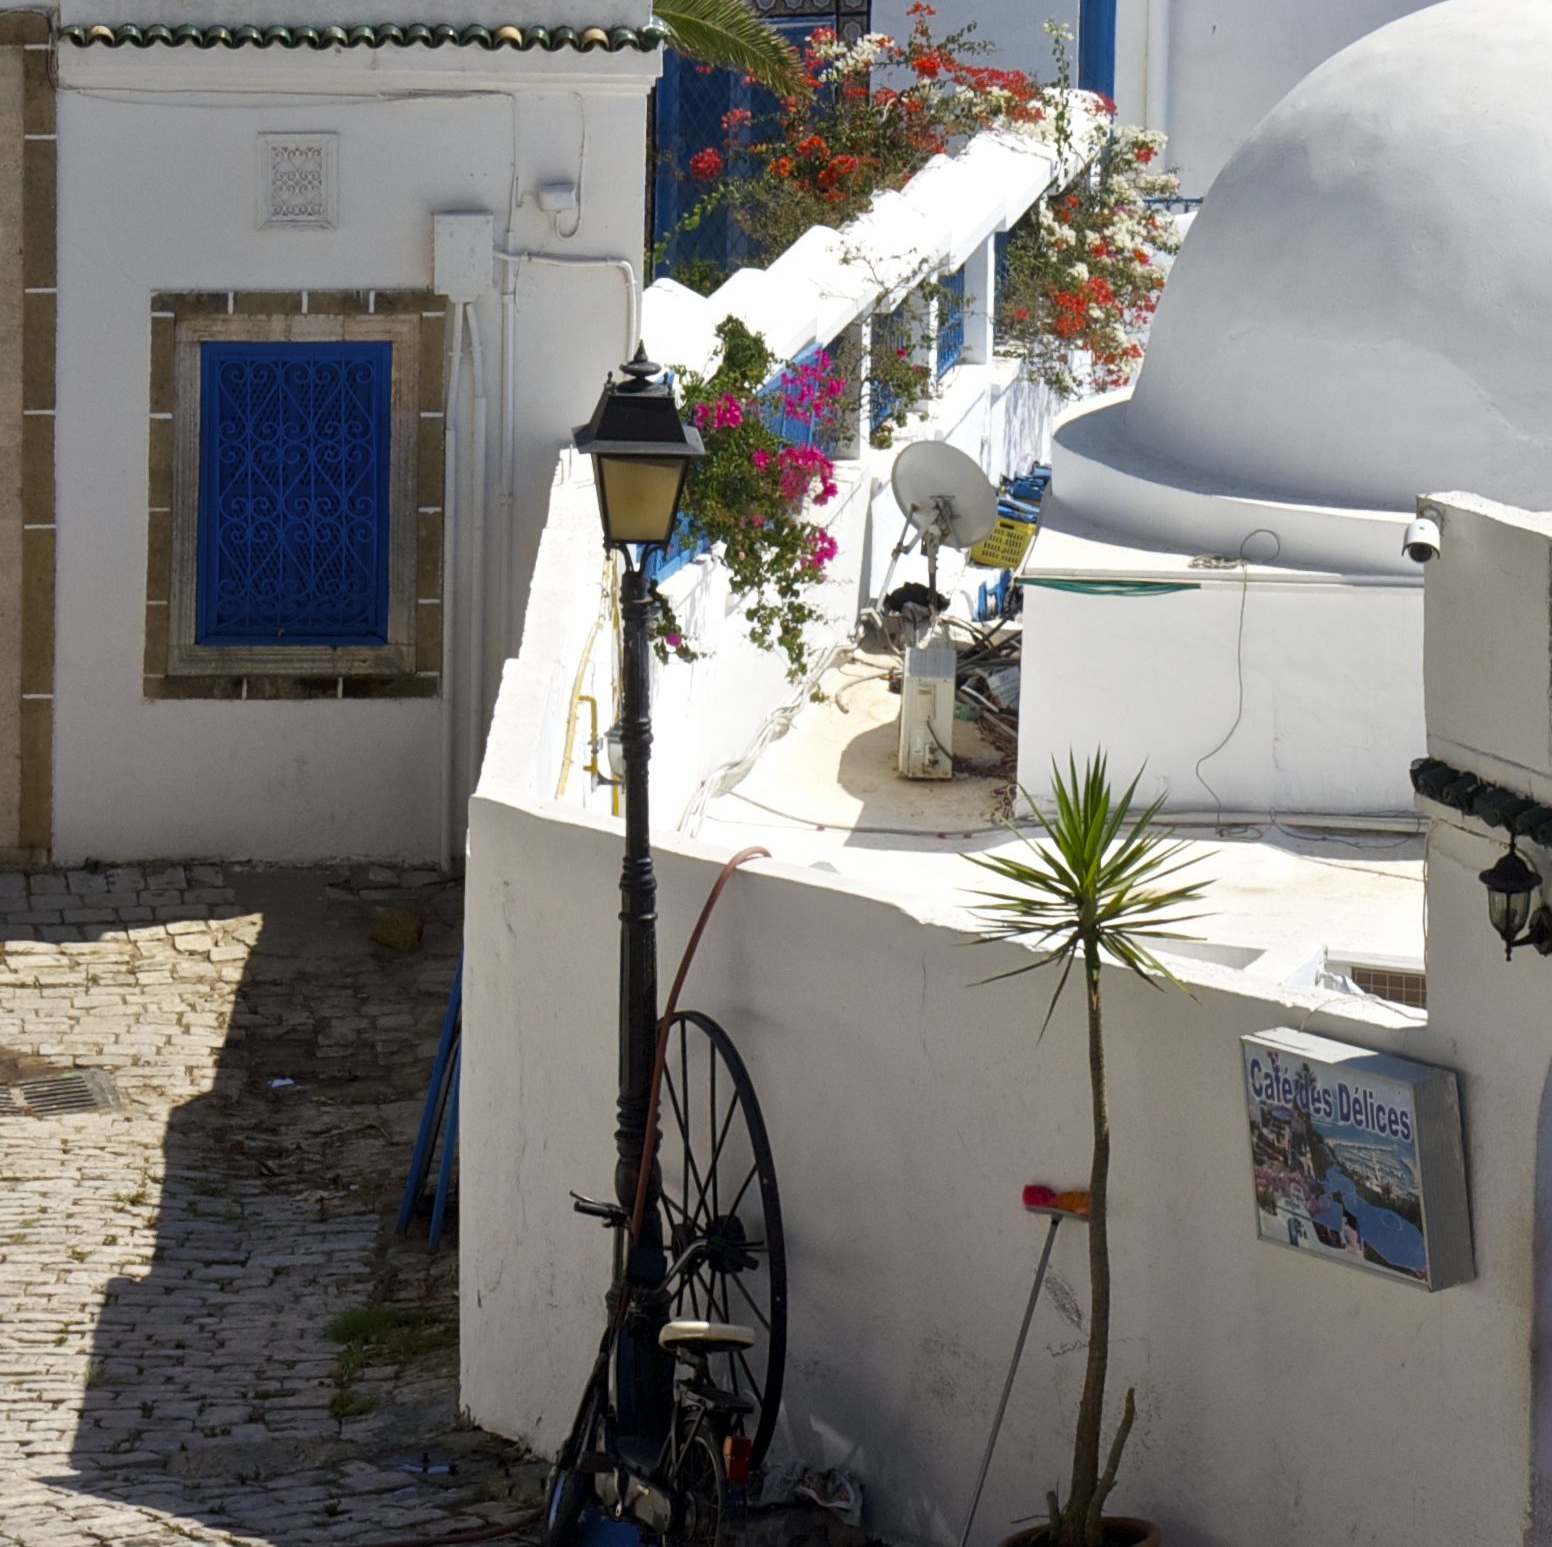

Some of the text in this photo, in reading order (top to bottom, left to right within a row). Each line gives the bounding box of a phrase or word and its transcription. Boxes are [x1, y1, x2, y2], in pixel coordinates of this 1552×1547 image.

[1249, 1057, 1411, 1141] Café des Délices
